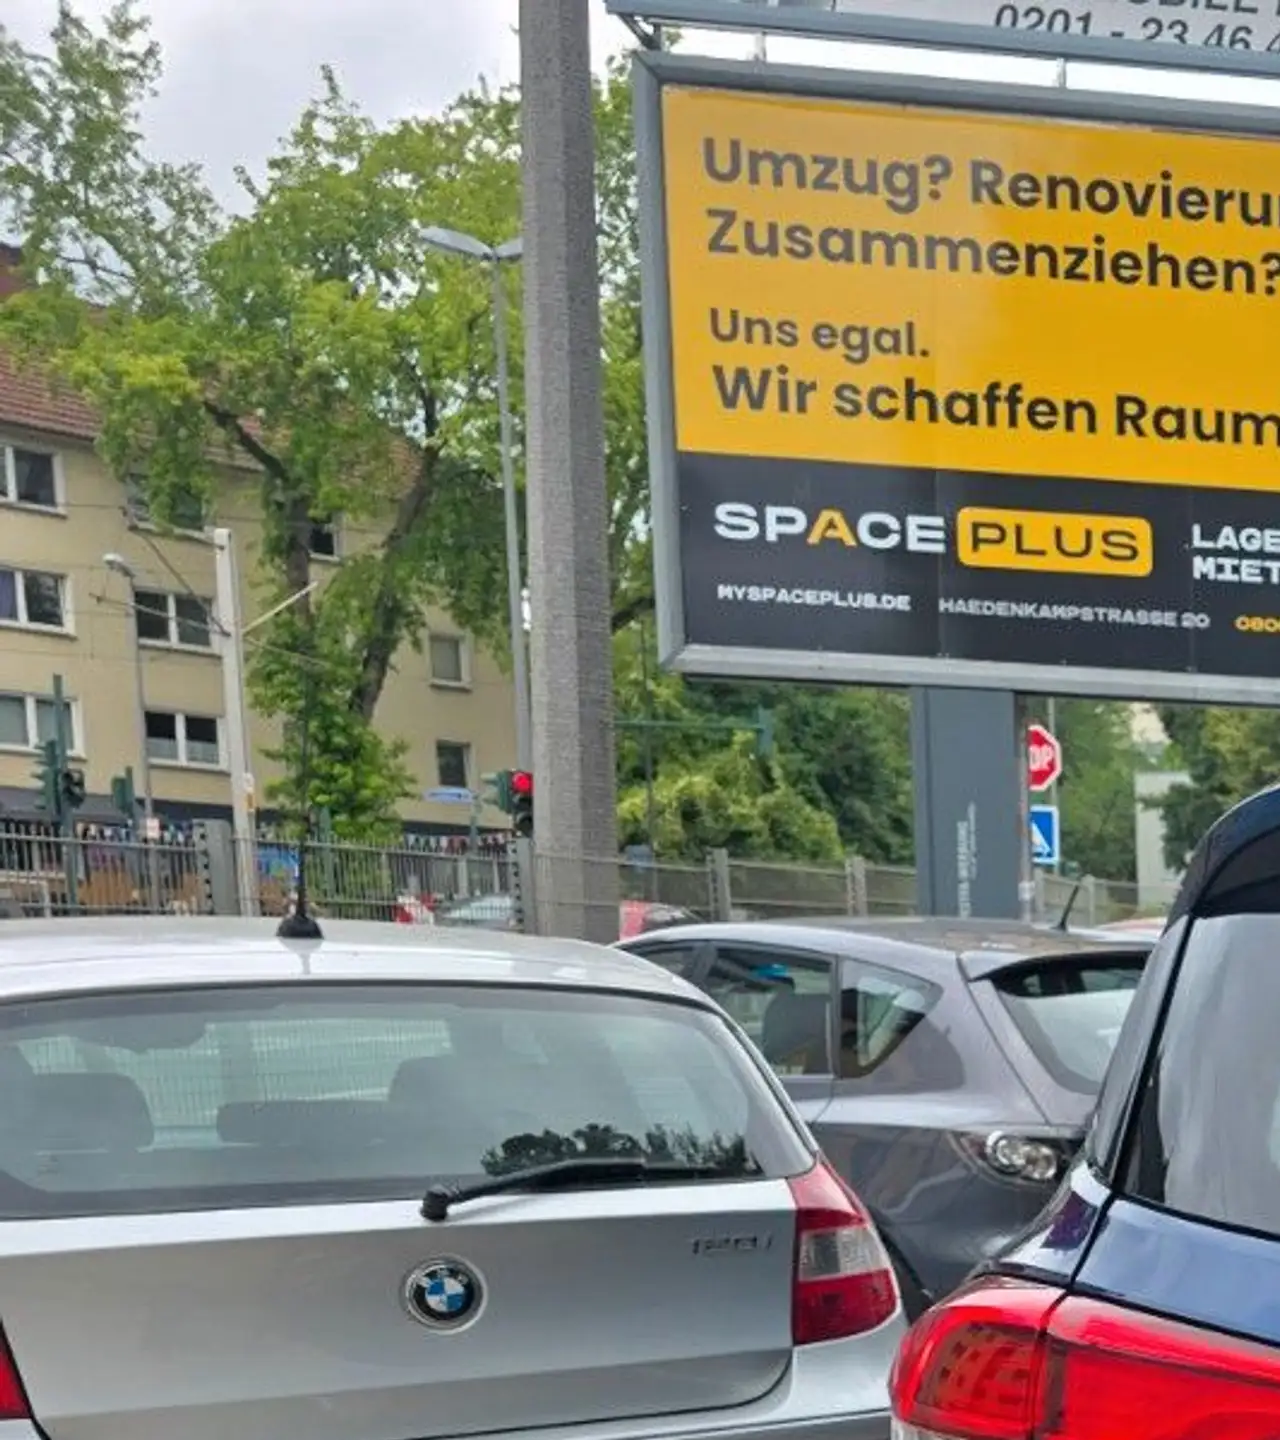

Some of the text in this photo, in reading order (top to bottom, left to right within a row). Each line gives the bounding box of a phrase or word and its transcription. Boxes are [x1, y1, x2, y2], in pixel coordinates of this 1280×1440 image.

[995, 4, 1091, 35] 0201
[1142, 17, 1188, 44] 23
[1203, 24, 1253, 50] 46
[703, 137, 953, 215] Umzug?
[710, 307, 929, 365] Uns egal.
[712, 364, 818, 413] Wir
[834, 377, 1097, 435] schaffen
[714, 502, 1139, 562] SPACE PLUS
[717, 584, 911, 611] MYSPACEPLUS.DE
[938, 598, 1177, 627] HAEDENKAMPSTRASSE
